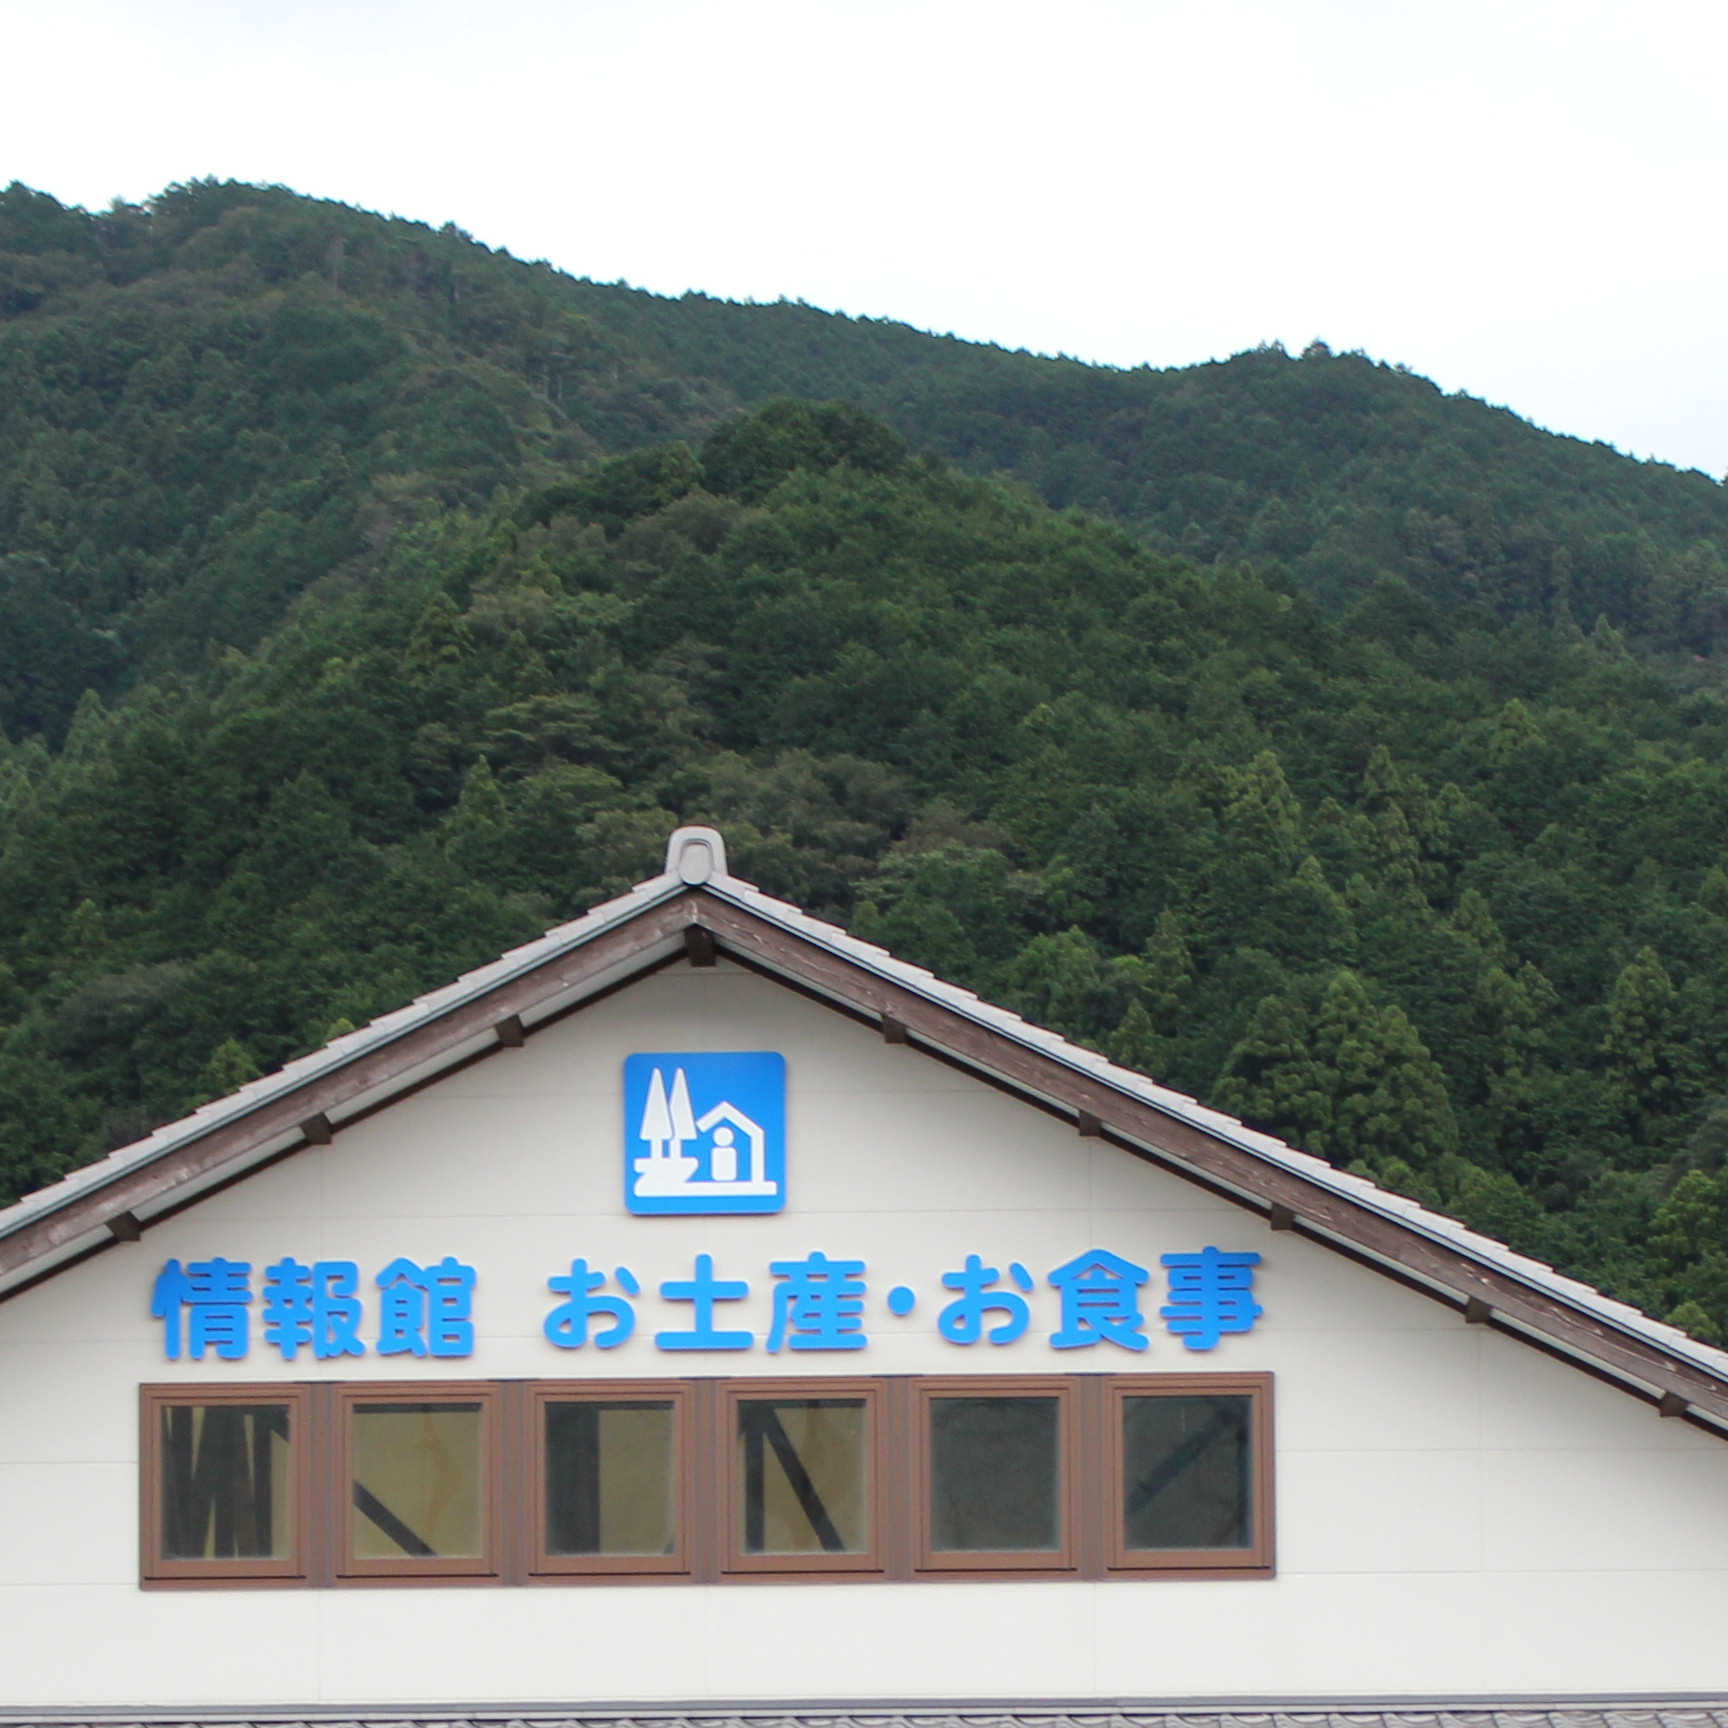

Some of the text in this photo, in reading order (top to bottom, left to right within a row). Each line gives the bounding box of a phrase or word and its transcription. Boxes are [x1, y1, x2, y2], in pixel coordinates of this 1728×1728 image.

[151, 1246, 1263, 1359] 情報館 お土産・お食事
